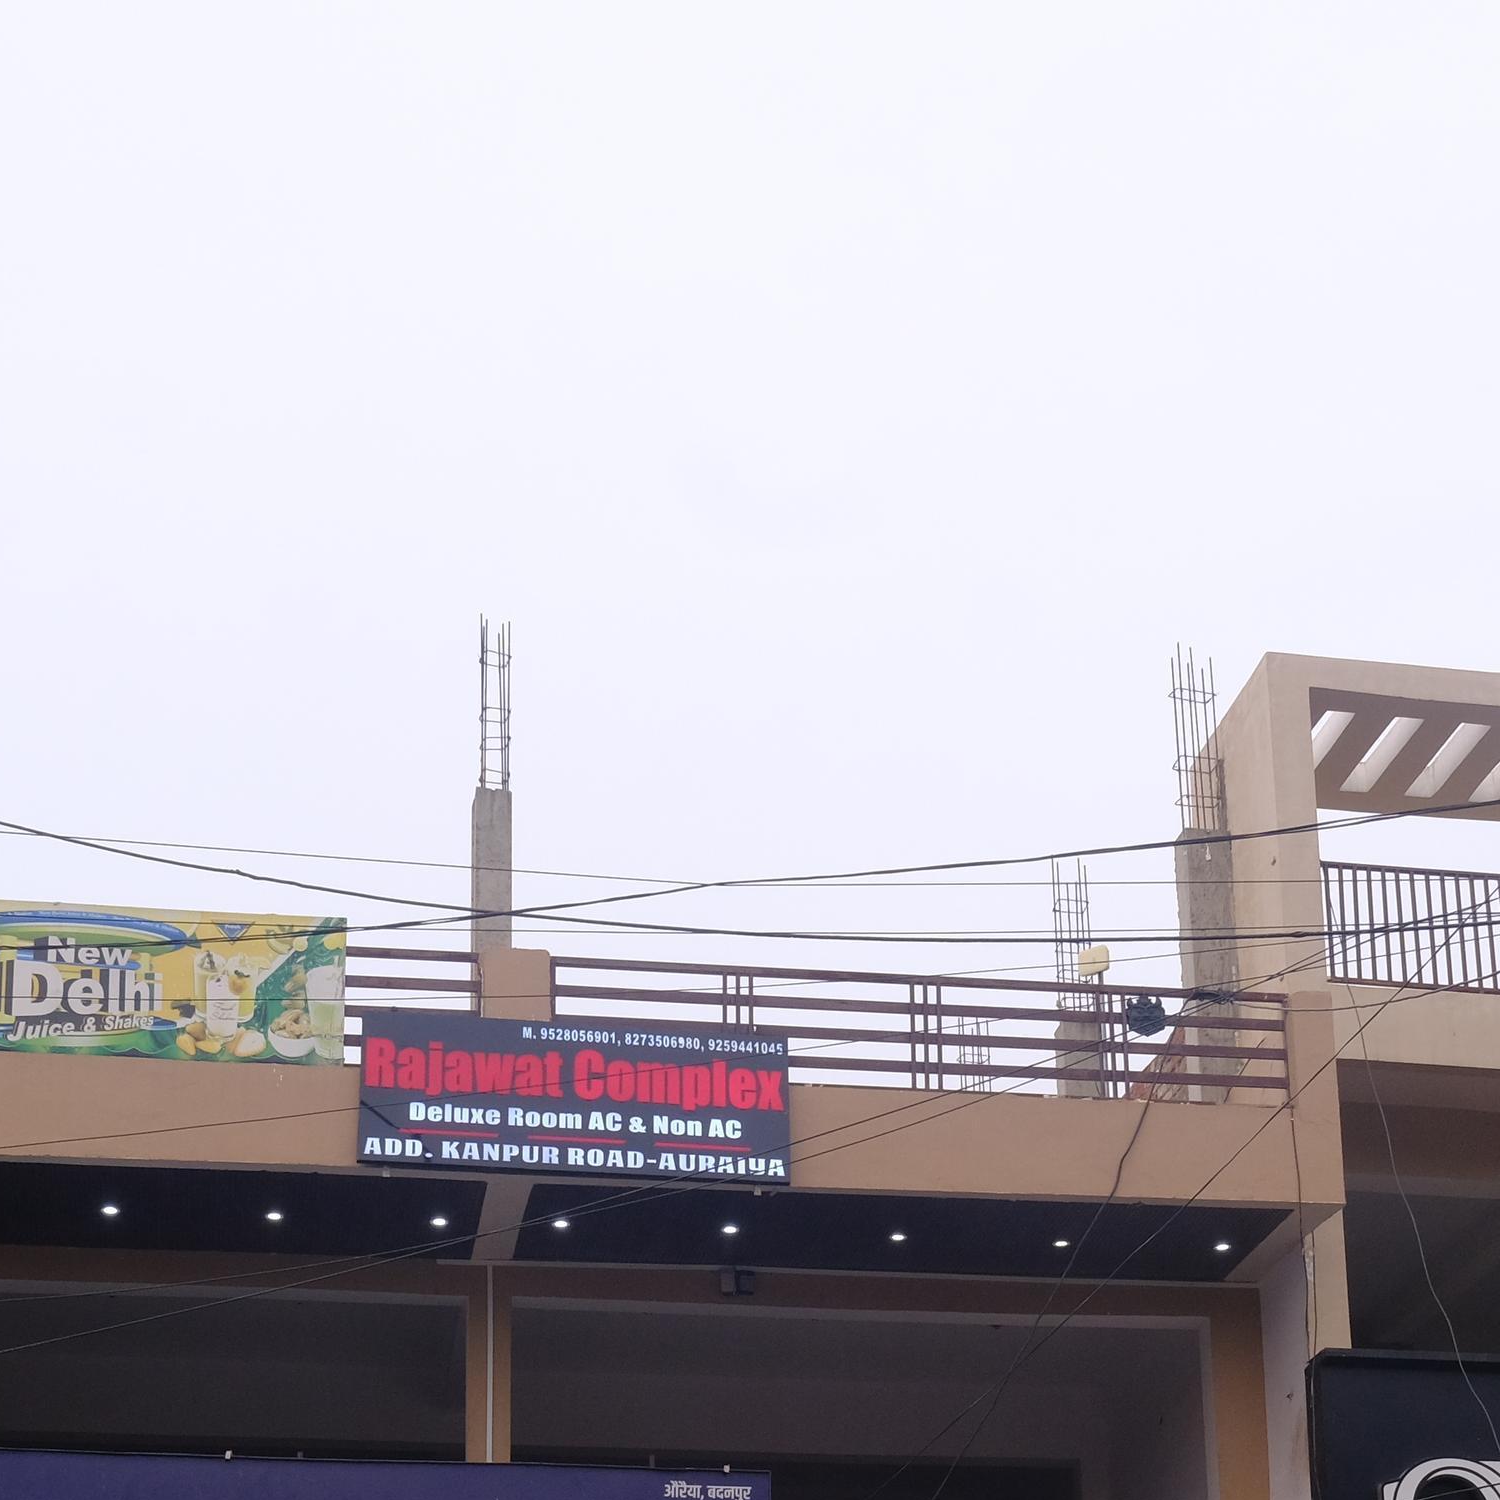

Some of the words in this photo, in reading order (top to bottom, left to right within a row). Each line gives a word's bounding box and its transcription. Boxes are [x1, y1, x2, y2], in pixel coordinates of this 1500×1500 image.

[47, 935, 133, 967] New
[7, 960, 164, 1017] Delhi
[7, 1016, 76, 1042] Juice
[82, 1015, 97, 1034] &
[102, 1012, 155, 1031] Shakes
[522, 1026, 537, 1040] M.
[540, 1027, 621, 1046] 9528056901,
[625, 1032, 705, 1052] 8273506980,
[708, 1038, 784, 1056] 9259441045
[364, 1037, 564, 1097] Rajawat
[573, 1049, 786, 1112] Complex
[408, 1101, 501, 1126] Deluxe
[507, 1107, 583, 1131] Room
[588, 1112, 623, 1133] AC
[628, 1115, 648, 1134] &
[652, 1115, 703, 1137] Non
[708, 1118, 742, 1140] AC
[363, 1136, 433, 1160] ADD.
[442, 1141, 560, 1165] KANPUR
